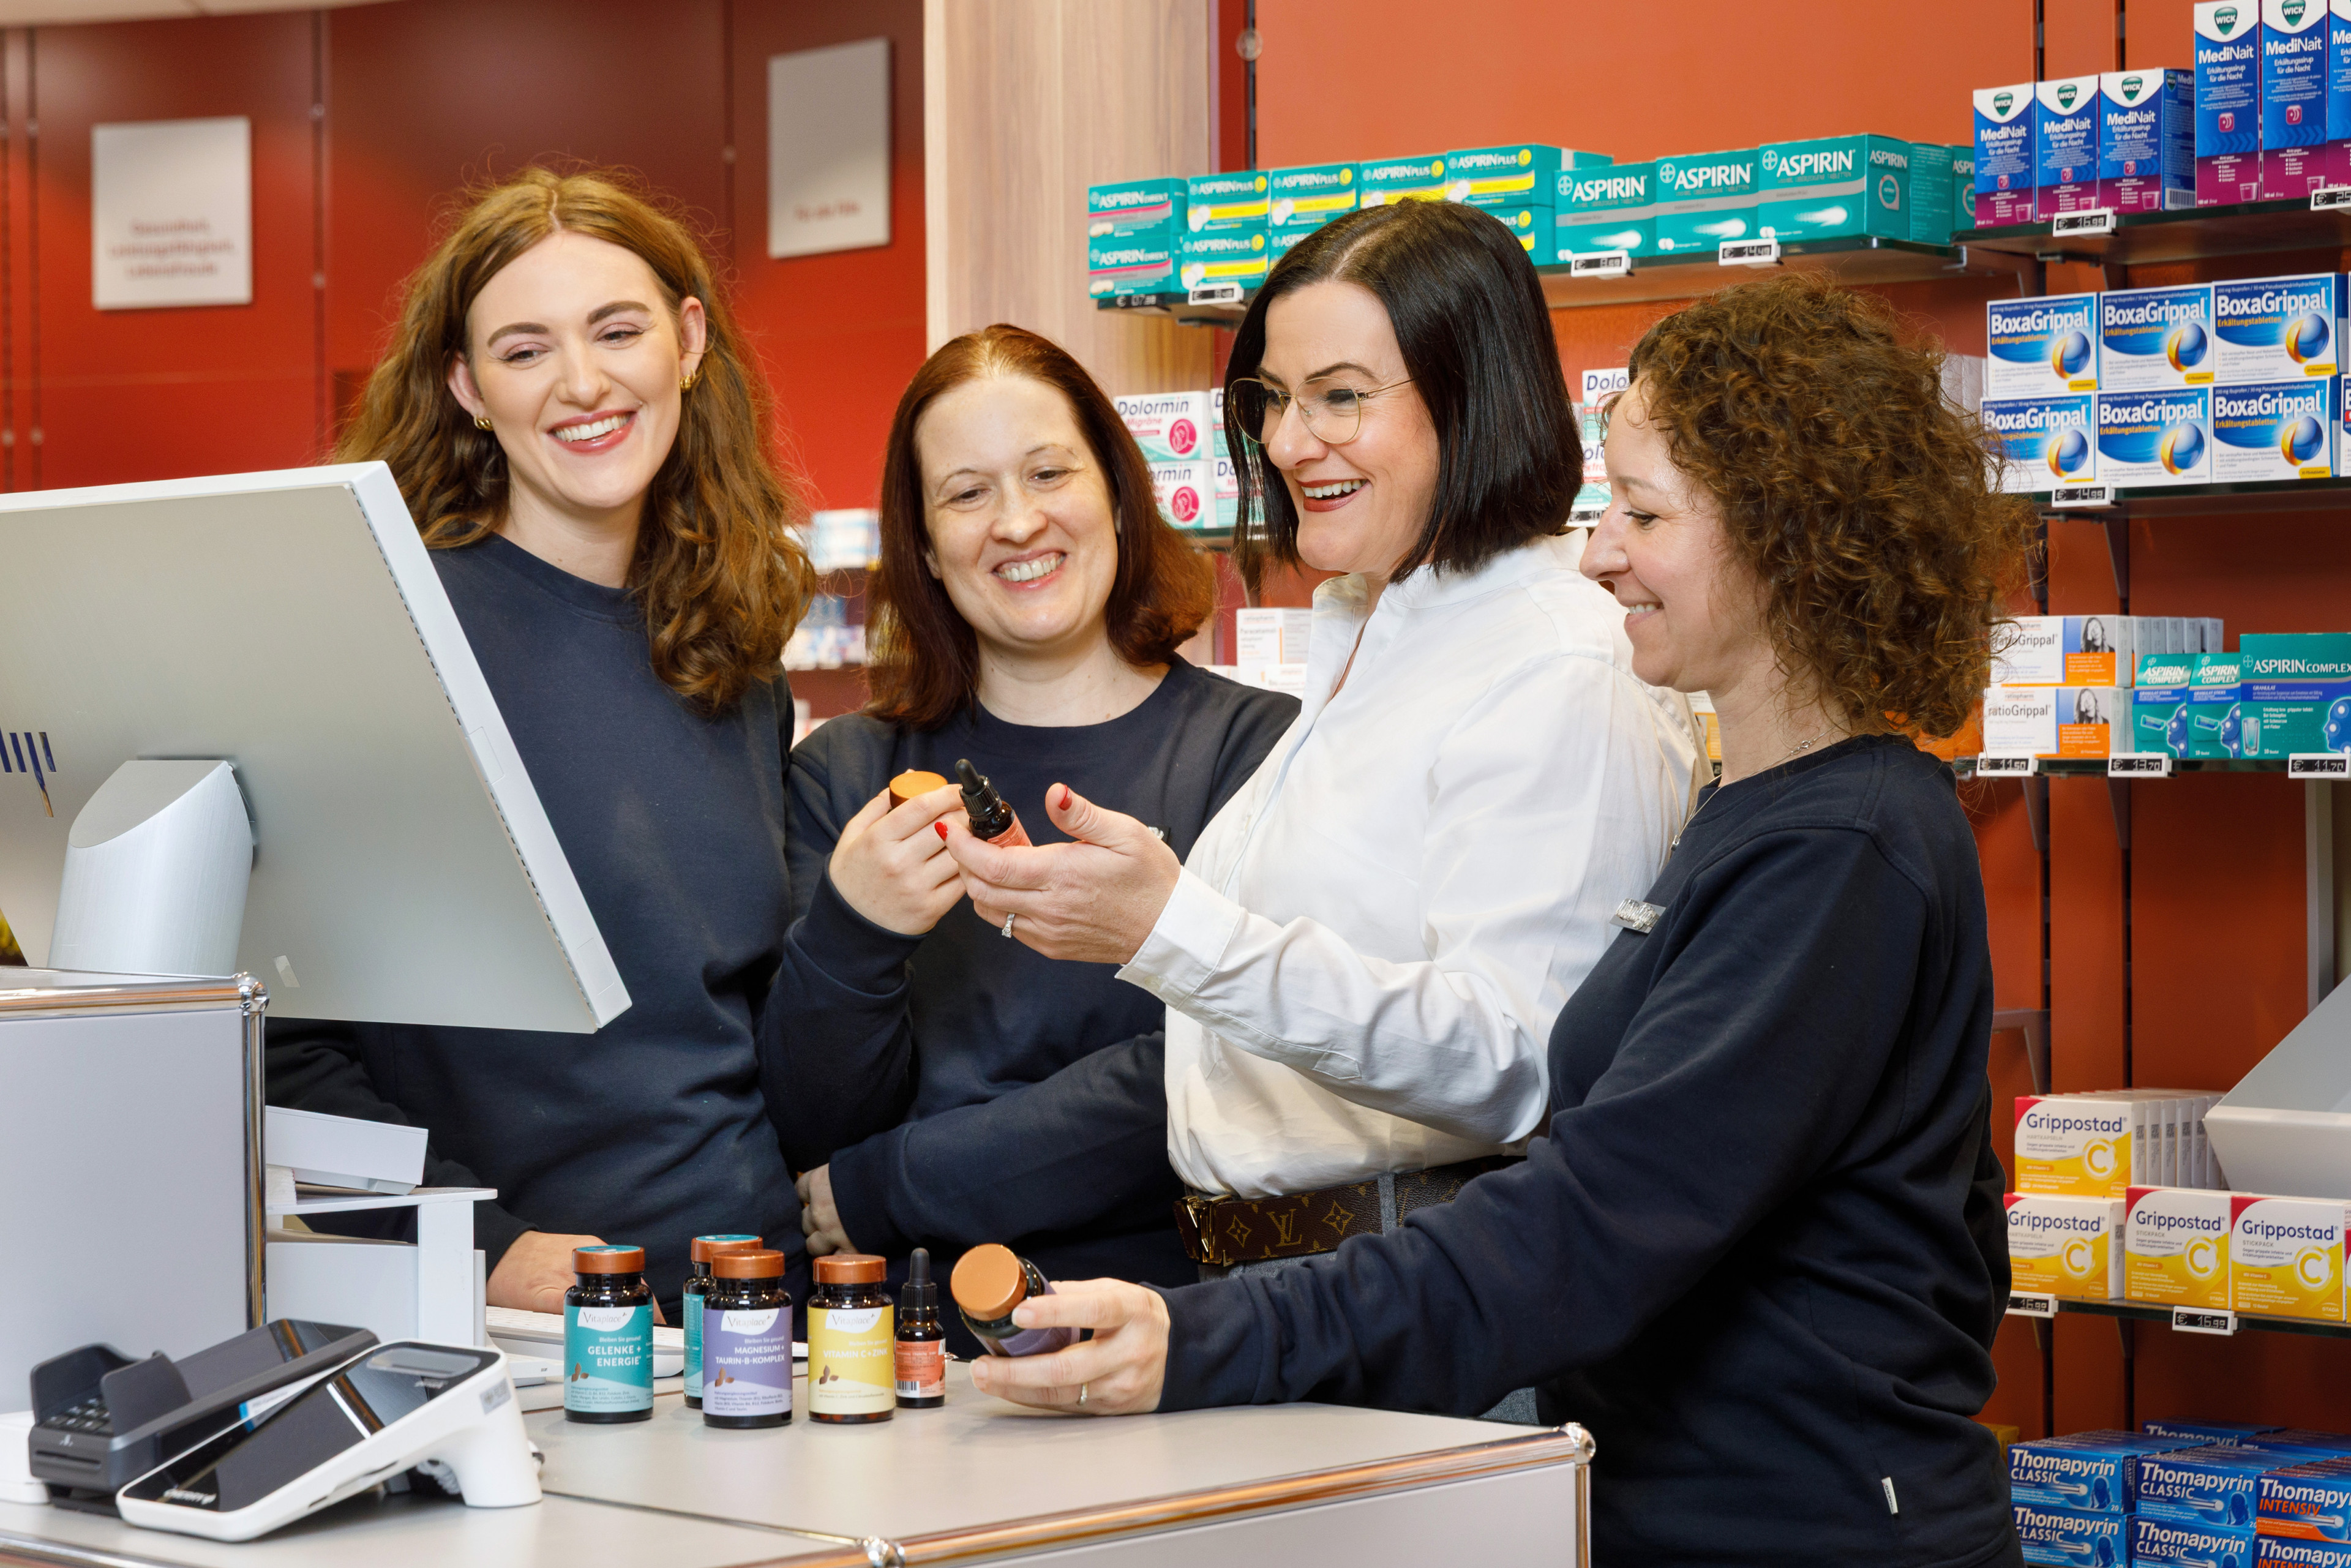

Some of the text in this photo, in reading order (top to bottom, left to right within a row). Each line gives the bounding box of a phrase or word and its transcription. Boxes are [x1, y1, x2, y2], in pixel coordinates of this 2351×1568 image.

[2284, 6, 2304, 15] WICK
[2216, 15, 2236, 24] WICK
[2266, 36, 2322, 56] MediNait
[2199, 45, 2254, 64] MediNait
[2274, 56, 2314, 67] Erkältungssirup
[2207, 65, 2246, 75] Erkältungssirup
[2295, 64, 2311, 72] Nacht
[2123, 83, 2141, 92] WICK
[2059, 91, 2075, 100] WICK
[2044, 118, 2091, 134] MediNait
[2107, 111, 2156, 126] MediNait
[1981, 126, 2027, 141] MediNait
[1458, 154, 1517, 168] ASPIRIN PLUS
[1777, 149, 1853, 178] ASPIRIN
[1869, 150, 1908, 169] ASPIRIN
[1953, 160, 1974, 174] ASPI
[1281, 173, 1338, 188] ASPIRIN PLUS
[1371, 165, 1430, 181] ASPIRIN PLUS
[1674, 163, 1750, 190] ASPIRIN
[1198, 181, 1235, 195] ASPIRIN
[1572, 175, 1645, 203] ASPIRIN
[1098, 191, 1144, 209] ASPIRIN
[2058, 219, 2068, 230] €
[1192, 239, 1232, 253] ASPIRIN
[1099, 249, 1144, 265] ASPIRIN
[2217, 287, 2327, 317] BoxaGrippal
[2104, 297, 2205, 326] BoxaGrippal
[1992, 306, 2089, 334] BoxaGrippal
[2218, 317, 2282, 327] Erkältungstabletten
[2105, 326, 2164, 337] Erkältungstabletten
[1992, 334, 2049, 345] Erkältungstabletten
[1118, 397, 1189, 416] Dolormin
[2100, 397, 2203, 426] BoxaGrippal
[2215, 390, 2321, 419] BoxaGrippal
[1984, 404, 2087, 432] BoxaGrippal
[2215, 418, 2278, 429] Erkältungstabletten
[2100, 426, 2161, 435] Erkältungstabletten
[2057, 489, 2067, 501] €
[2143, 666, 2185, 677] ASPIRIN
[2198, 664, 2239, 677] ASPIRIN
[2253, 659, 2351, 673] ASPIRIN COMPLEX
[2147, 675, 2181, 684] COMPLEX
[2202, 675, 2235, 684] COMPLEX
[1988, 704, 2048, 718] ratioGrippal
[2113, 759, 2123, 771] €
[2293, 760, 2303, 771] €
[2027, 1113, 2122, 1133] Grippostad
[2087, 1144, 2108, 1173] C
[2009, 1211, 2100, 1232] Grippostad
[2136, 1210, 2221, 1231] Grippostad
[2243, 1220, 2334, 1240] Grippostad
[2066, 1243, 2086, 1272] C
[2189, 1243, 2210, 1274] C
[2300, 1253, 2322, 1284] C
[583, 1311, 621, 1324] Vitaplace
[727, 1316, 766, 1327] Vitaplace
[832, 1314, 871, 1326] Vitaplace
[2177, 1314, 2188, 1325] €
[588, 1345, 634, 1355] GELENKE
[735, 1345, 780, 1354] MAGNESIUM
[823, 1349, 858, 1358] VITAMIN
[2011, 1449, 2115, 1477] Thomapyrin
[2011, 1468, 2061, 1484] CLASSIC
[2142, 1462, 2254, 1493] Thomapyrin
[2140, 1482, 2195, 1499] CLASSIC
[2260, 1478, 2351, 1509] Thomapy
[2259, 1498, 2322, 1517] INTENSIV
[2014, 1507, 2119, 1536] Thomapyrin
[2137, 1521, 2246, 1553] Thomapyrin
[2136, 1541, 2189, 1559] CLASSIC
